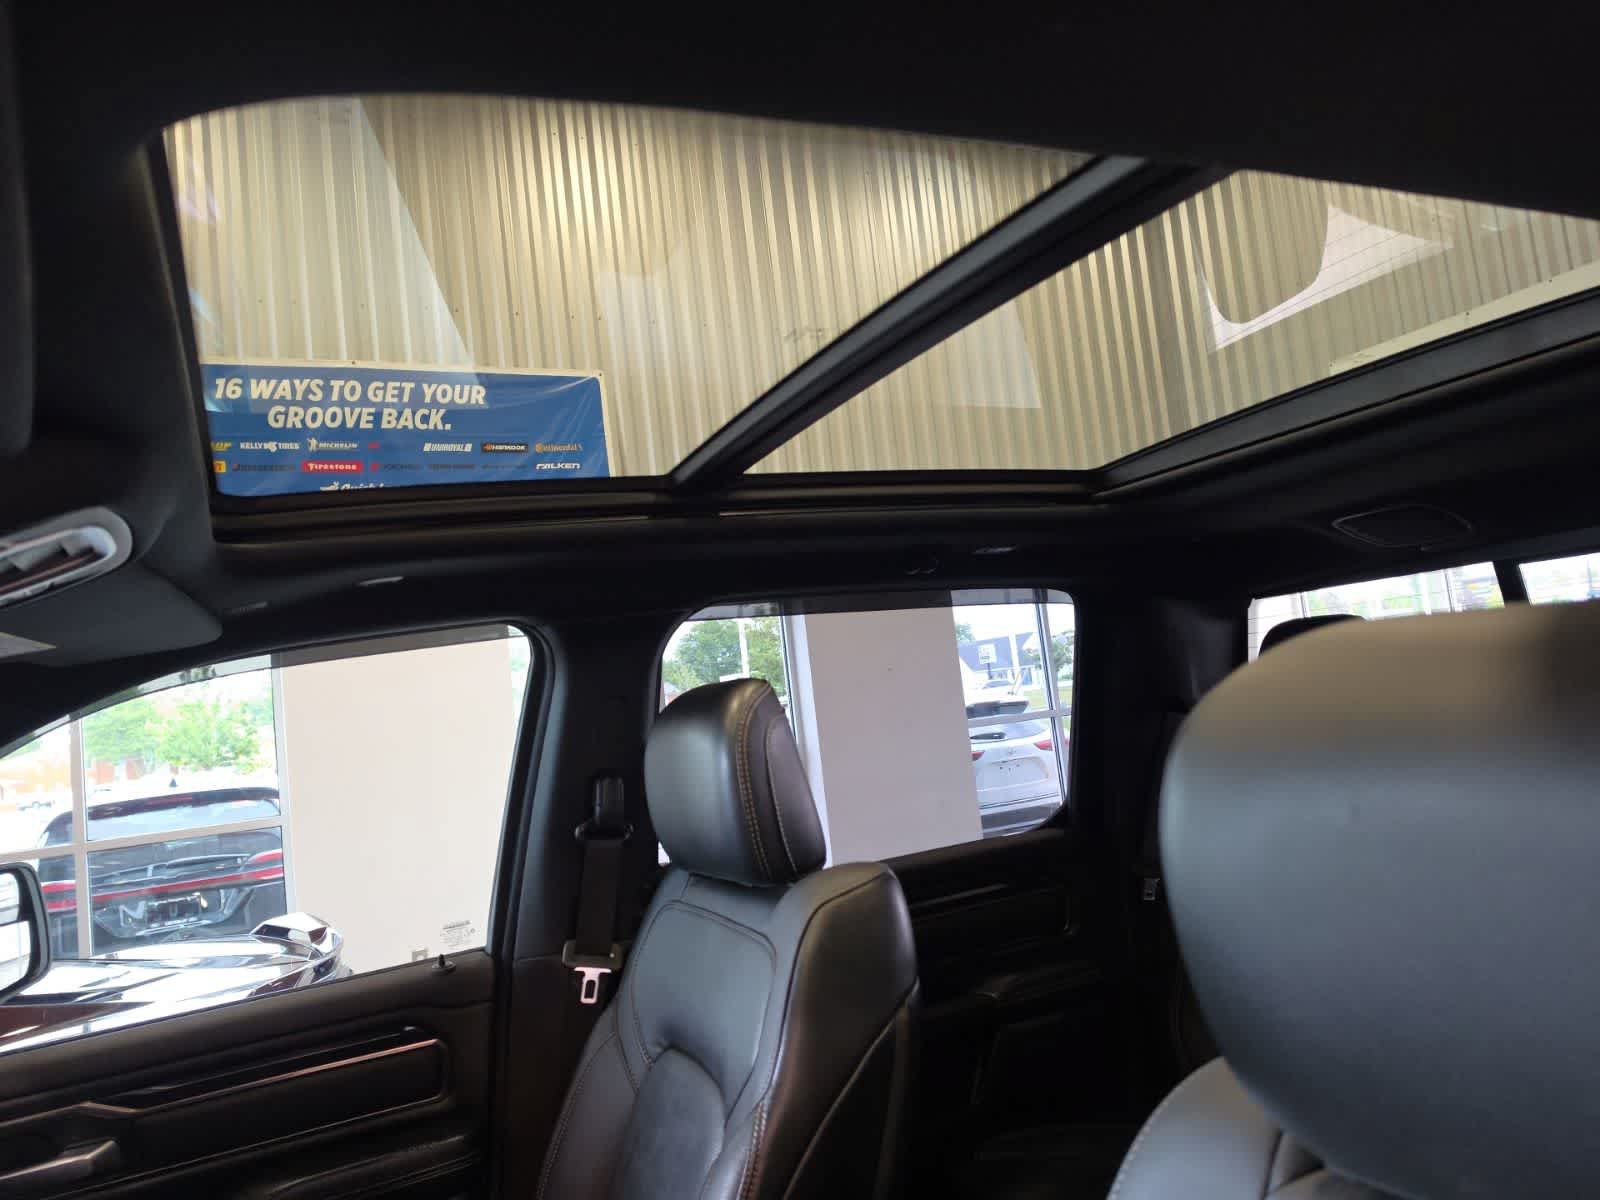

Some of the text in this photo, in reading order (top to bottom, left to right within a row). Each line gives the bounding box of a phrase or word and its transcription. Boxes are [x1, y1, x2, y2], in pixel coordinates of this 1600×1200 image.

[215, 378, 486, 405] 16 WAYS TO GET YOUR
[267, 406, 452, 430] GROOVE BACK.
[318, 441, 358, 449] MICHELIN
